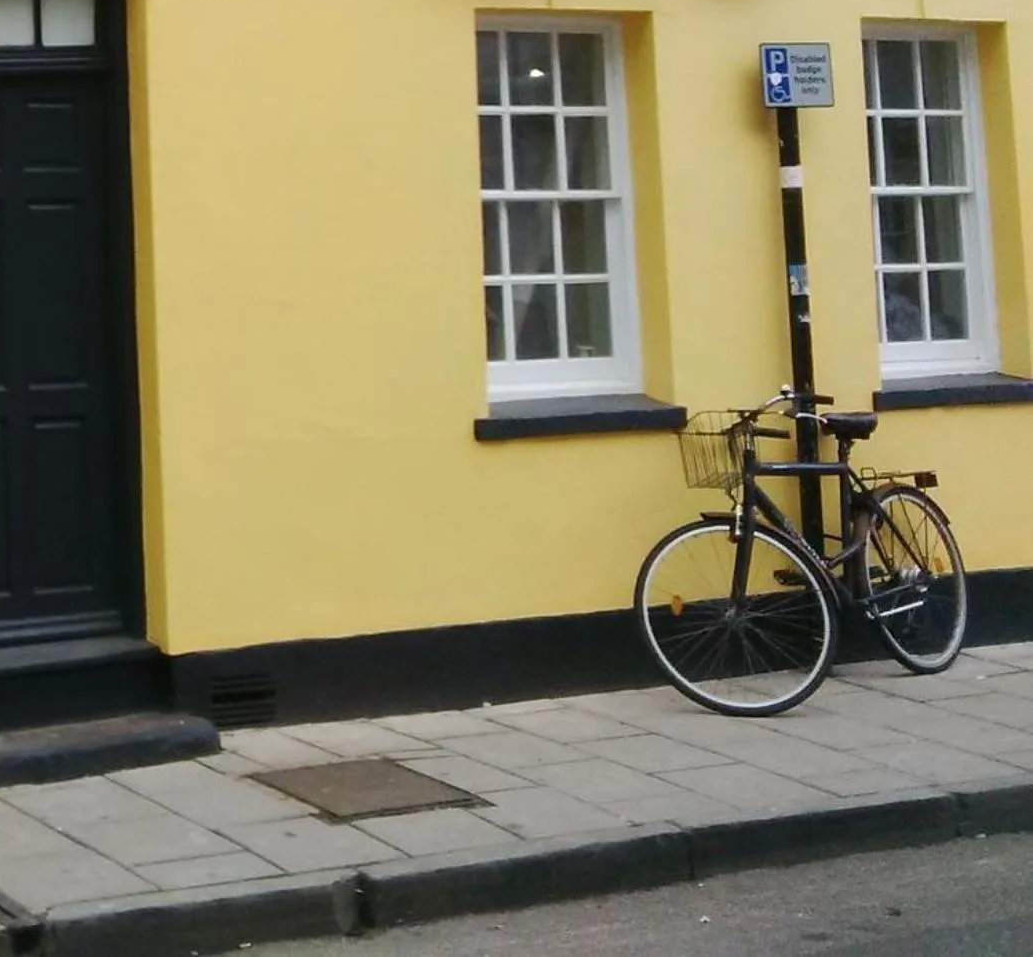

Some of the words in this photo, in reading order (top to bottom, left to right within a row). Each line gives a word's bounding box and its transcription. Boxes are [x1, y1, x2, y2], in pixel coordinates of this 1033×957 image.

[789, 54, 826, 63] Disabled
[796, 65, 821, 75] badge
[794, 75, 826, 83] holders
[801, 86, 820, 95] only
